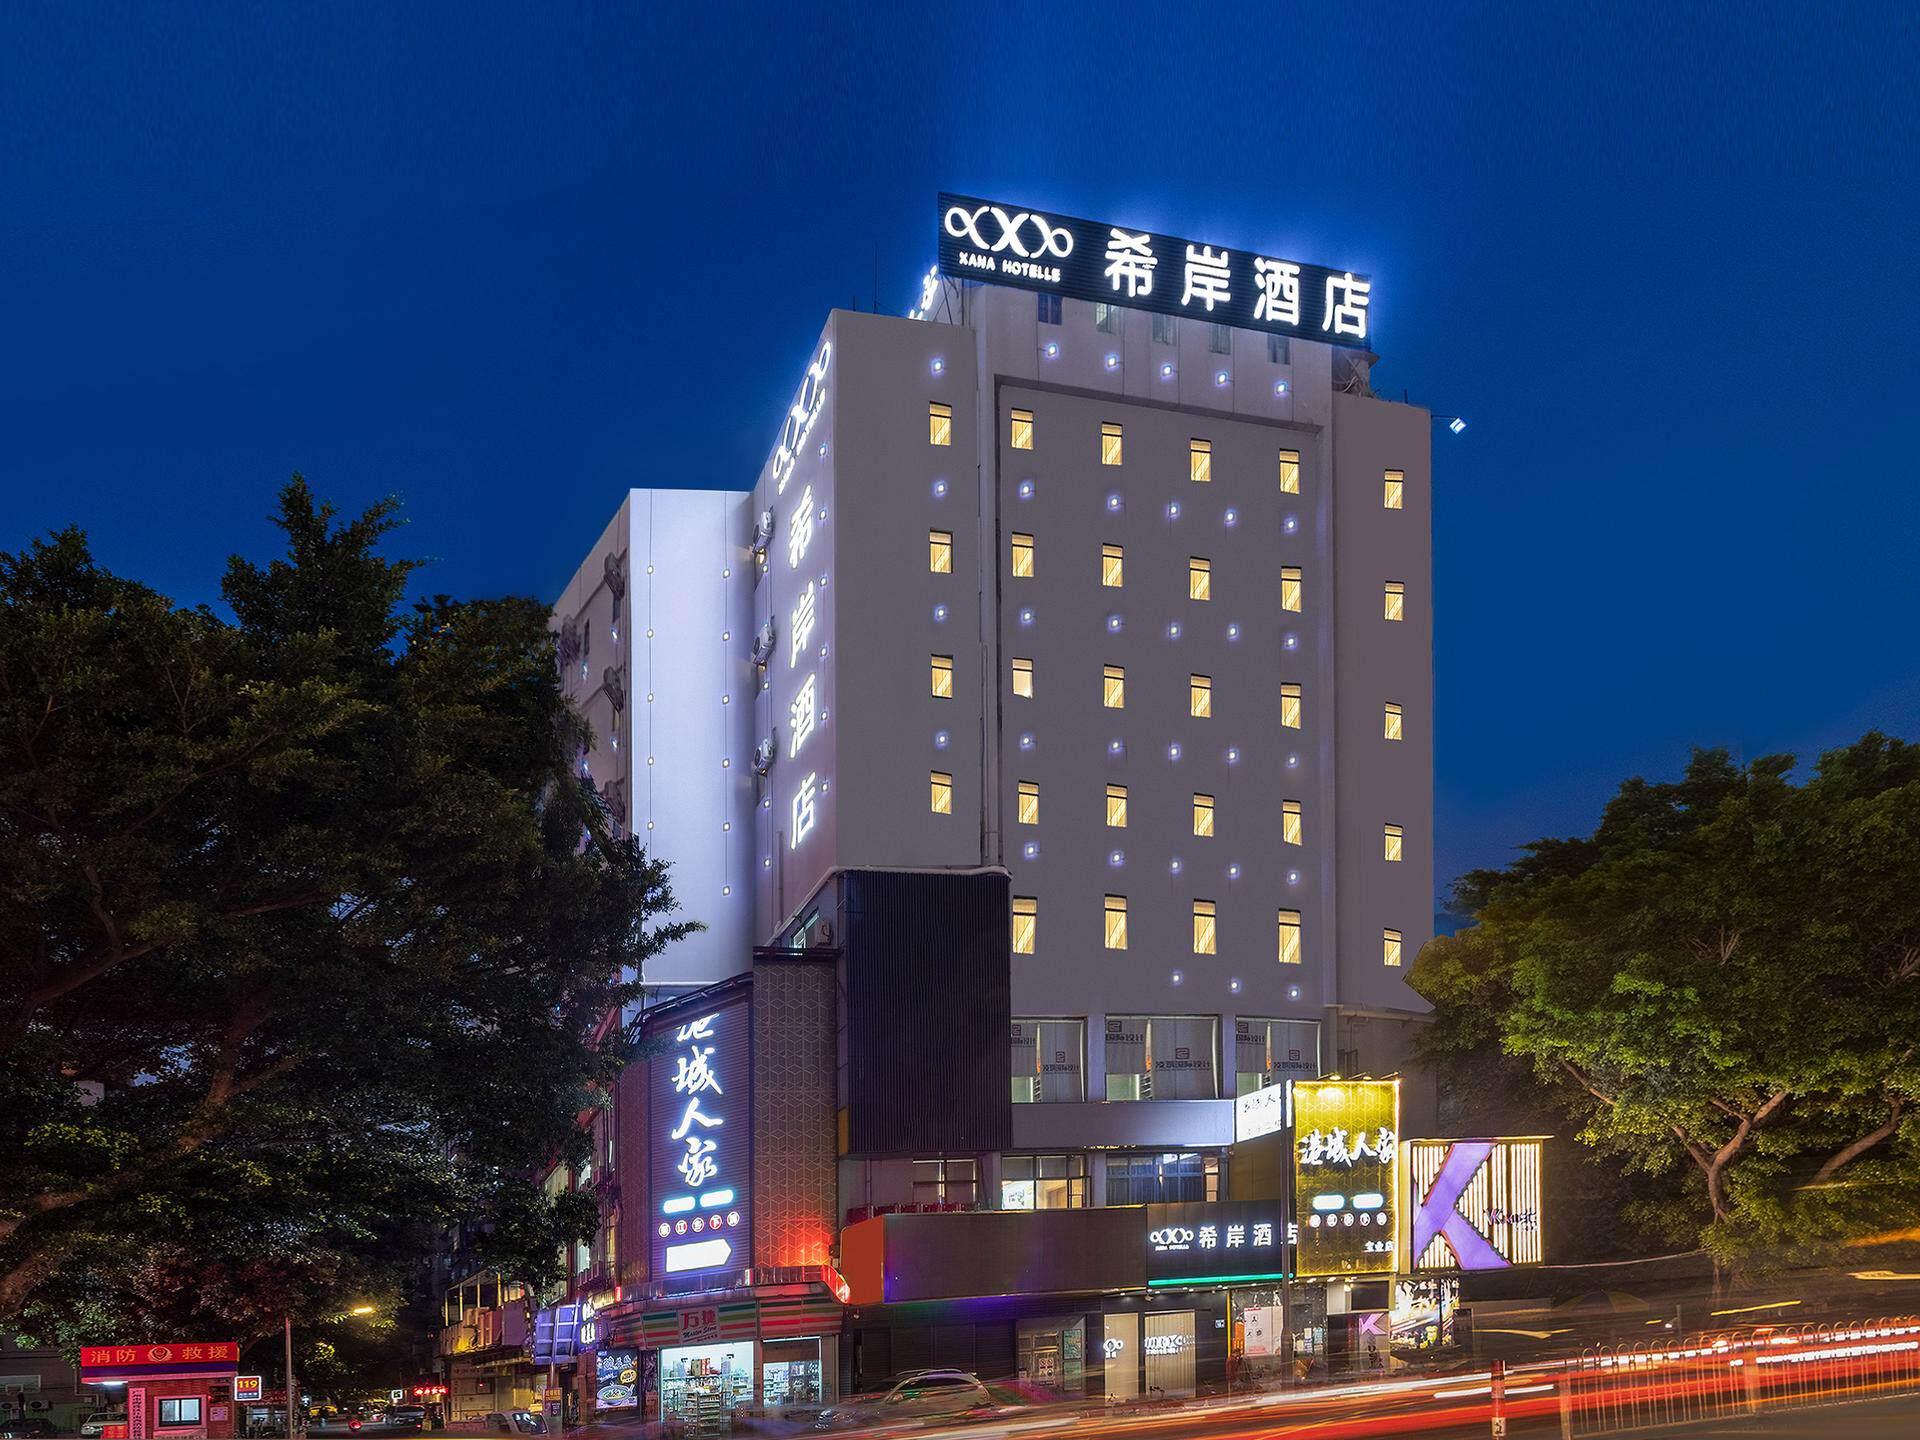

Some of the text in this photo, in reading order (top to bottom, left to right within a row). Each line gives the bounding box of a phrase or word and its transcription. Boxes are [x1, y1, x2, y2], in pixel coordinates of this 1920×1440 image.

[1104, 228, 1370, 338] 希岸酒店
[789, 484, 816, 851] 希岸酒店
[91, 1346, 229, 1364] 消防 救援
[238, 1379, 258, 1390] 119
